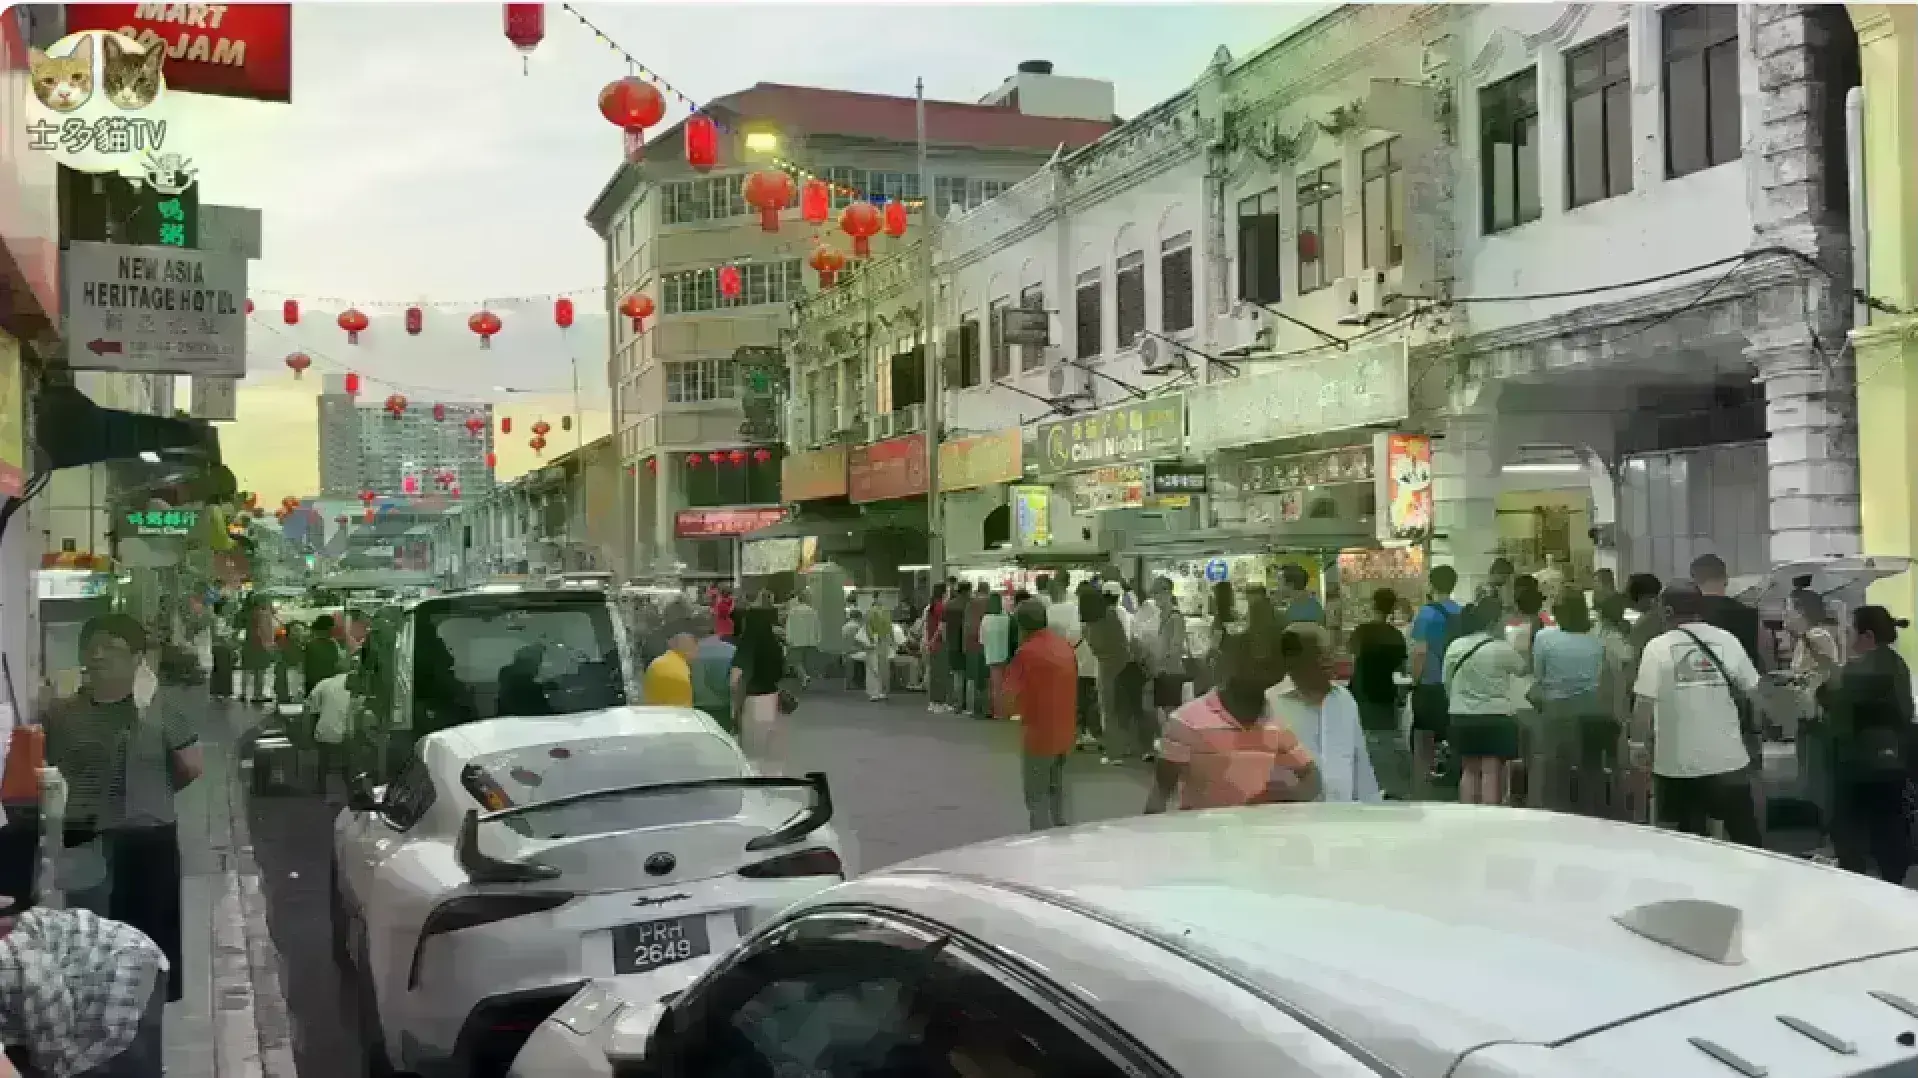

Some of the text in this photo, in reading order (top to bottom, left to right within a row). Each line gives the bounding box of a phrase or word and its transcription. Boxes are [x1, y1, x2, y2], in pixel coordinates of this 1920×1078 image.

[134, 4, 229, 29] MART
[164, 33, 246, 67] JAM
[118, 255, 204, 285] NEW ASIA
[83, 281, 237, 315] HERITAGE HOTEL
[640, 919, 683, 943] PRH
[634, 939, 691, 965] 2649
